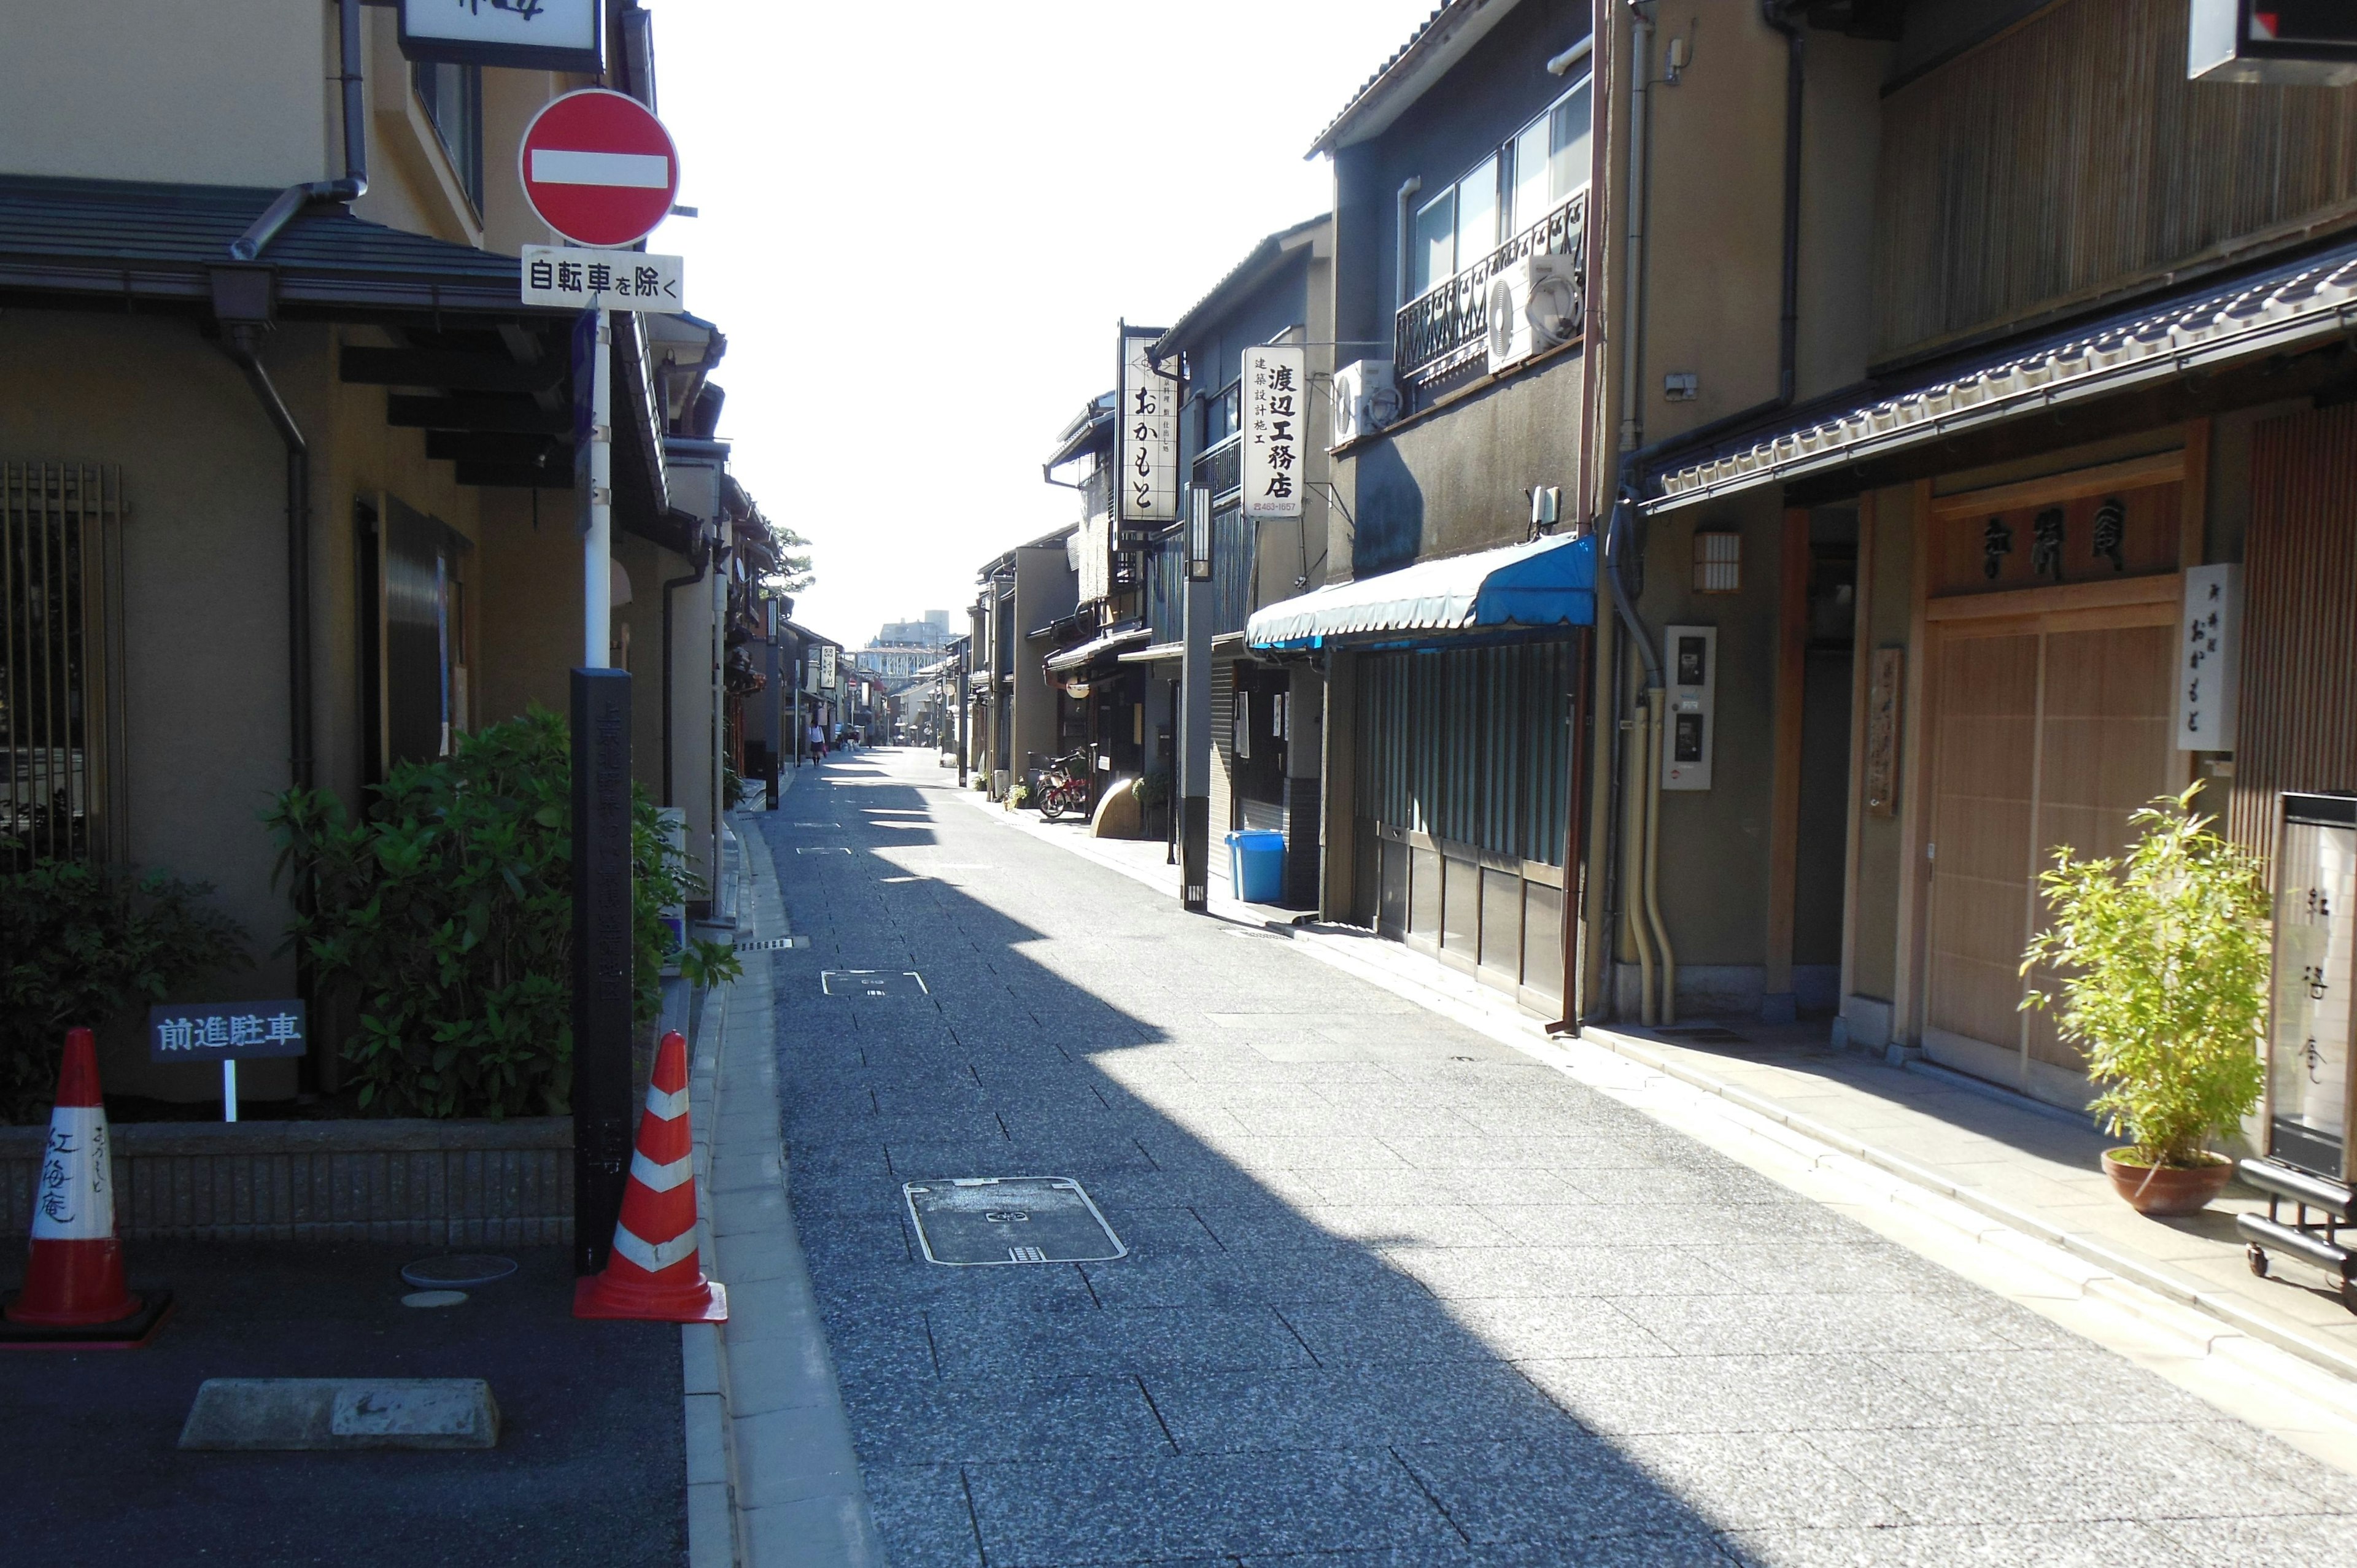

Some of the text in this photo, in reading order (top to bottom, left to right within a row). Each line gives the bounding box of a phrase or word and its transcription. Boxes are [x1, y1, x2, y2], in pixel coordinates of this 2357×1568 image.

[531, 258, 676, 299] 自転車を除く
[1133, 387, 1158, 508] おかもと
[1253, 357, 1268, 444] 建築設計施工
[1264, 364, 1298, 499] 渡辺工務店
[2188, 619, 2205, 732] おかもと
[158, 1013, 301, 1051] 前進駐車
